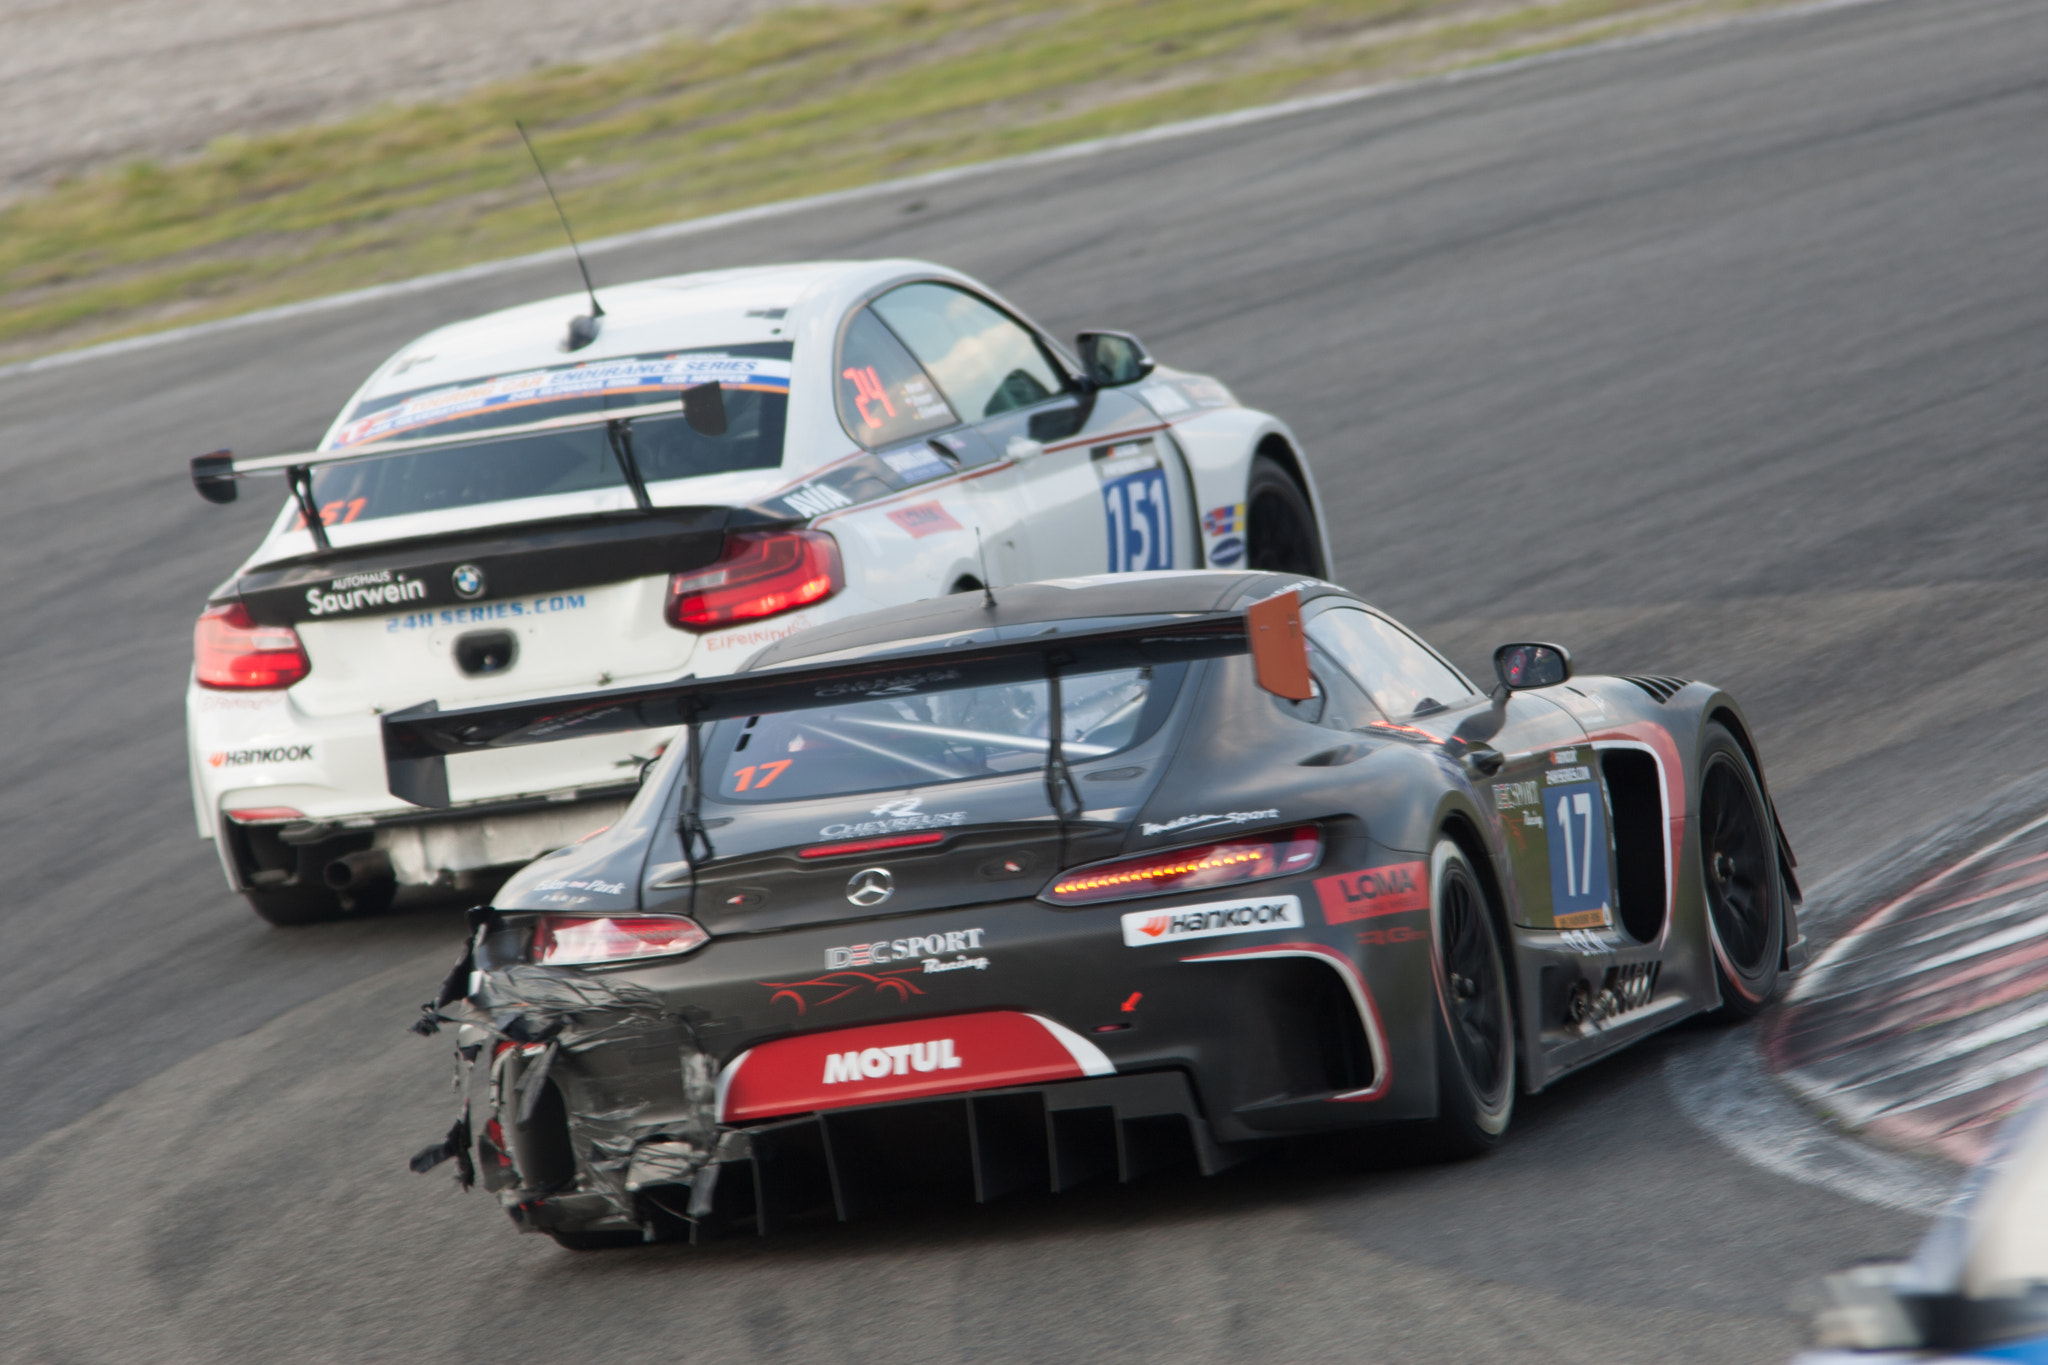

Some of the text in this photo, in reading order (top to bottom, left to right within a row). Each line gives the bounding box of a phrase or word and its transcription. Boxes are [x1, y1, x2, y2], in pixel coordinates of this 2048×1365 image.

[551, 361, 676, 383] ENDURANCE
[682, 360, 759, 372] SERIES
[842, 366, 896, 429] 24
[1108, 478, 1167, 572] 151
[306, 575, 426, 615] Saurwein
[332, 571, 390, 590] AUTOHAUS
[386, 594, 586, 633] 24H SERIES.COM
[733, 758, 793, 793] 17
[1557, 792, 1592, 897] 17
[1340, 869, 1416, 902] LOMA
[890, 927, 984, 960] SPORT
[822, 1038, 962, 1085] MOTUL
